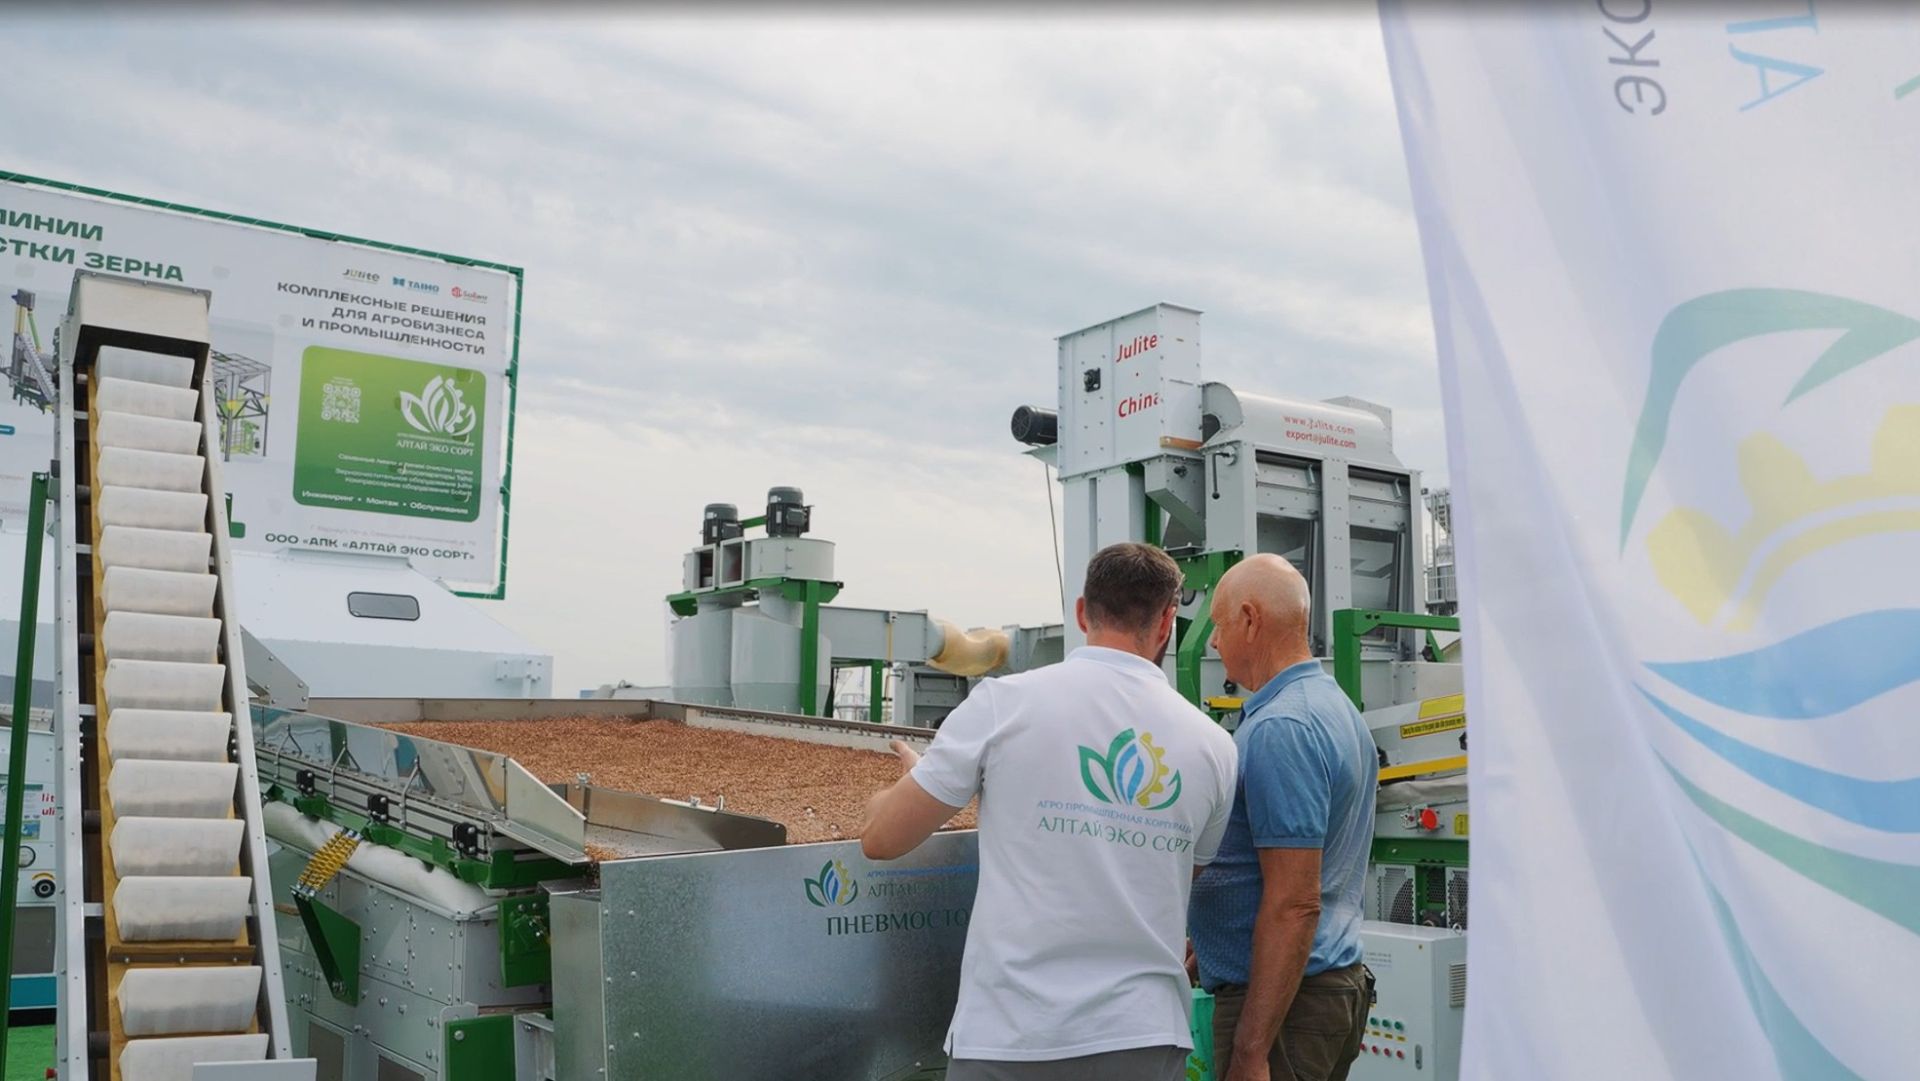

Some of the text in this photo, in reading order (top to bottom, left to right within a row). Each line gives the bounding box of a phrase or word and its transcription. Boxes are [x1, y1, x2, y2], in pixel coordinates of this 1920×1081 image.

[0, 208, 104, 242] ИНИИ
[84, 251, 184, 282] ЗЕРНА
[408, 280, 440, 293] TAIHO
[277, 281, 487, 326] КОМПЛЕКСНЫЕ РЕШЕНИЯ
[302, 317, 486, 355] И ПРОМЫШЛЕННОСТИ
[331, 307, 486, 341] ДЛЯ АГРОБИЗНЕСА
[1116, 334, 1158, 363] Julite
[396, 439, 428, 451] АЛТАЙ
[429, 443, 449, 454] ЭКО
[450, 446, 474, 457] СОРТ
[265, 532, 299, 545] ООО
[303, 537, 338, 549] «АПК
[342, 541, 397, 554] «АЛТАЙ
[400, 545, 429, 557] ЭКО
[432, 549, 476, 561] СОРТ»
[1104, 824, 1147, 848] ЭКО
